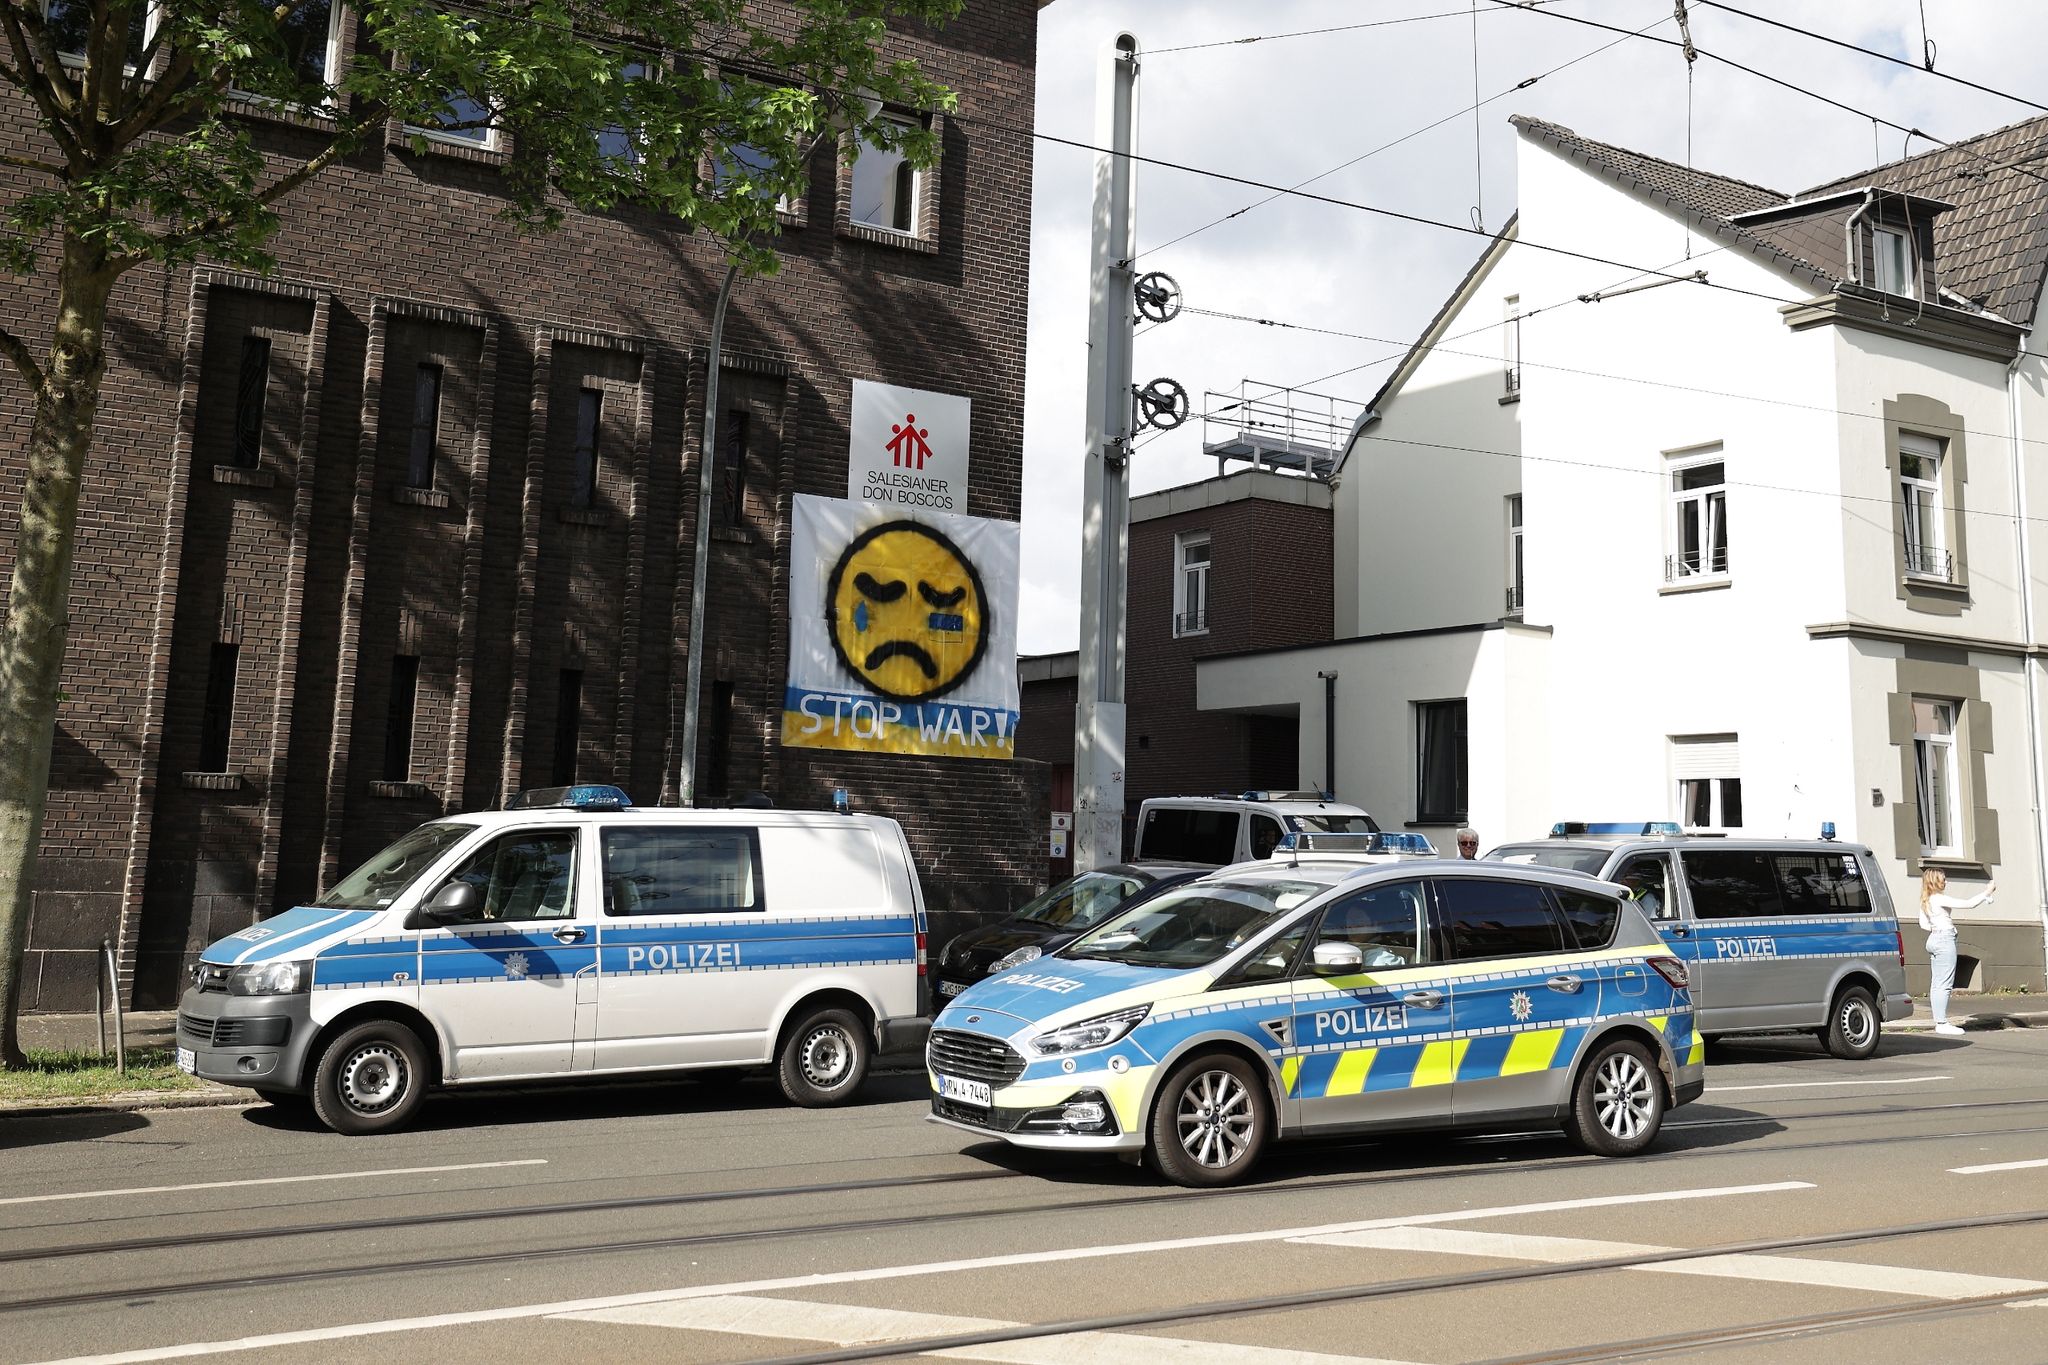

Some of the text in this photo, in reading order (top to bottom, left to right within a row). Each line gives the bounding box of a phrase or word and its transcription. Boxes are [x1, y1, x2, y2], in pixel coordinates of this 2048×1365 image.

[867, 470, 949, 493] SALESIANER
[862, 485, 953, 509] DON BOSCOS
[800, 693, 1010, 748] STOP WAR!
[628, 943, 741, 970] POLIZEI
[1713, 936, 1777, 958] POLIZEI
[991, 973, 1086, 994] POLIZEI
[1315, 1005, 1408, 1037] POLIZEI
